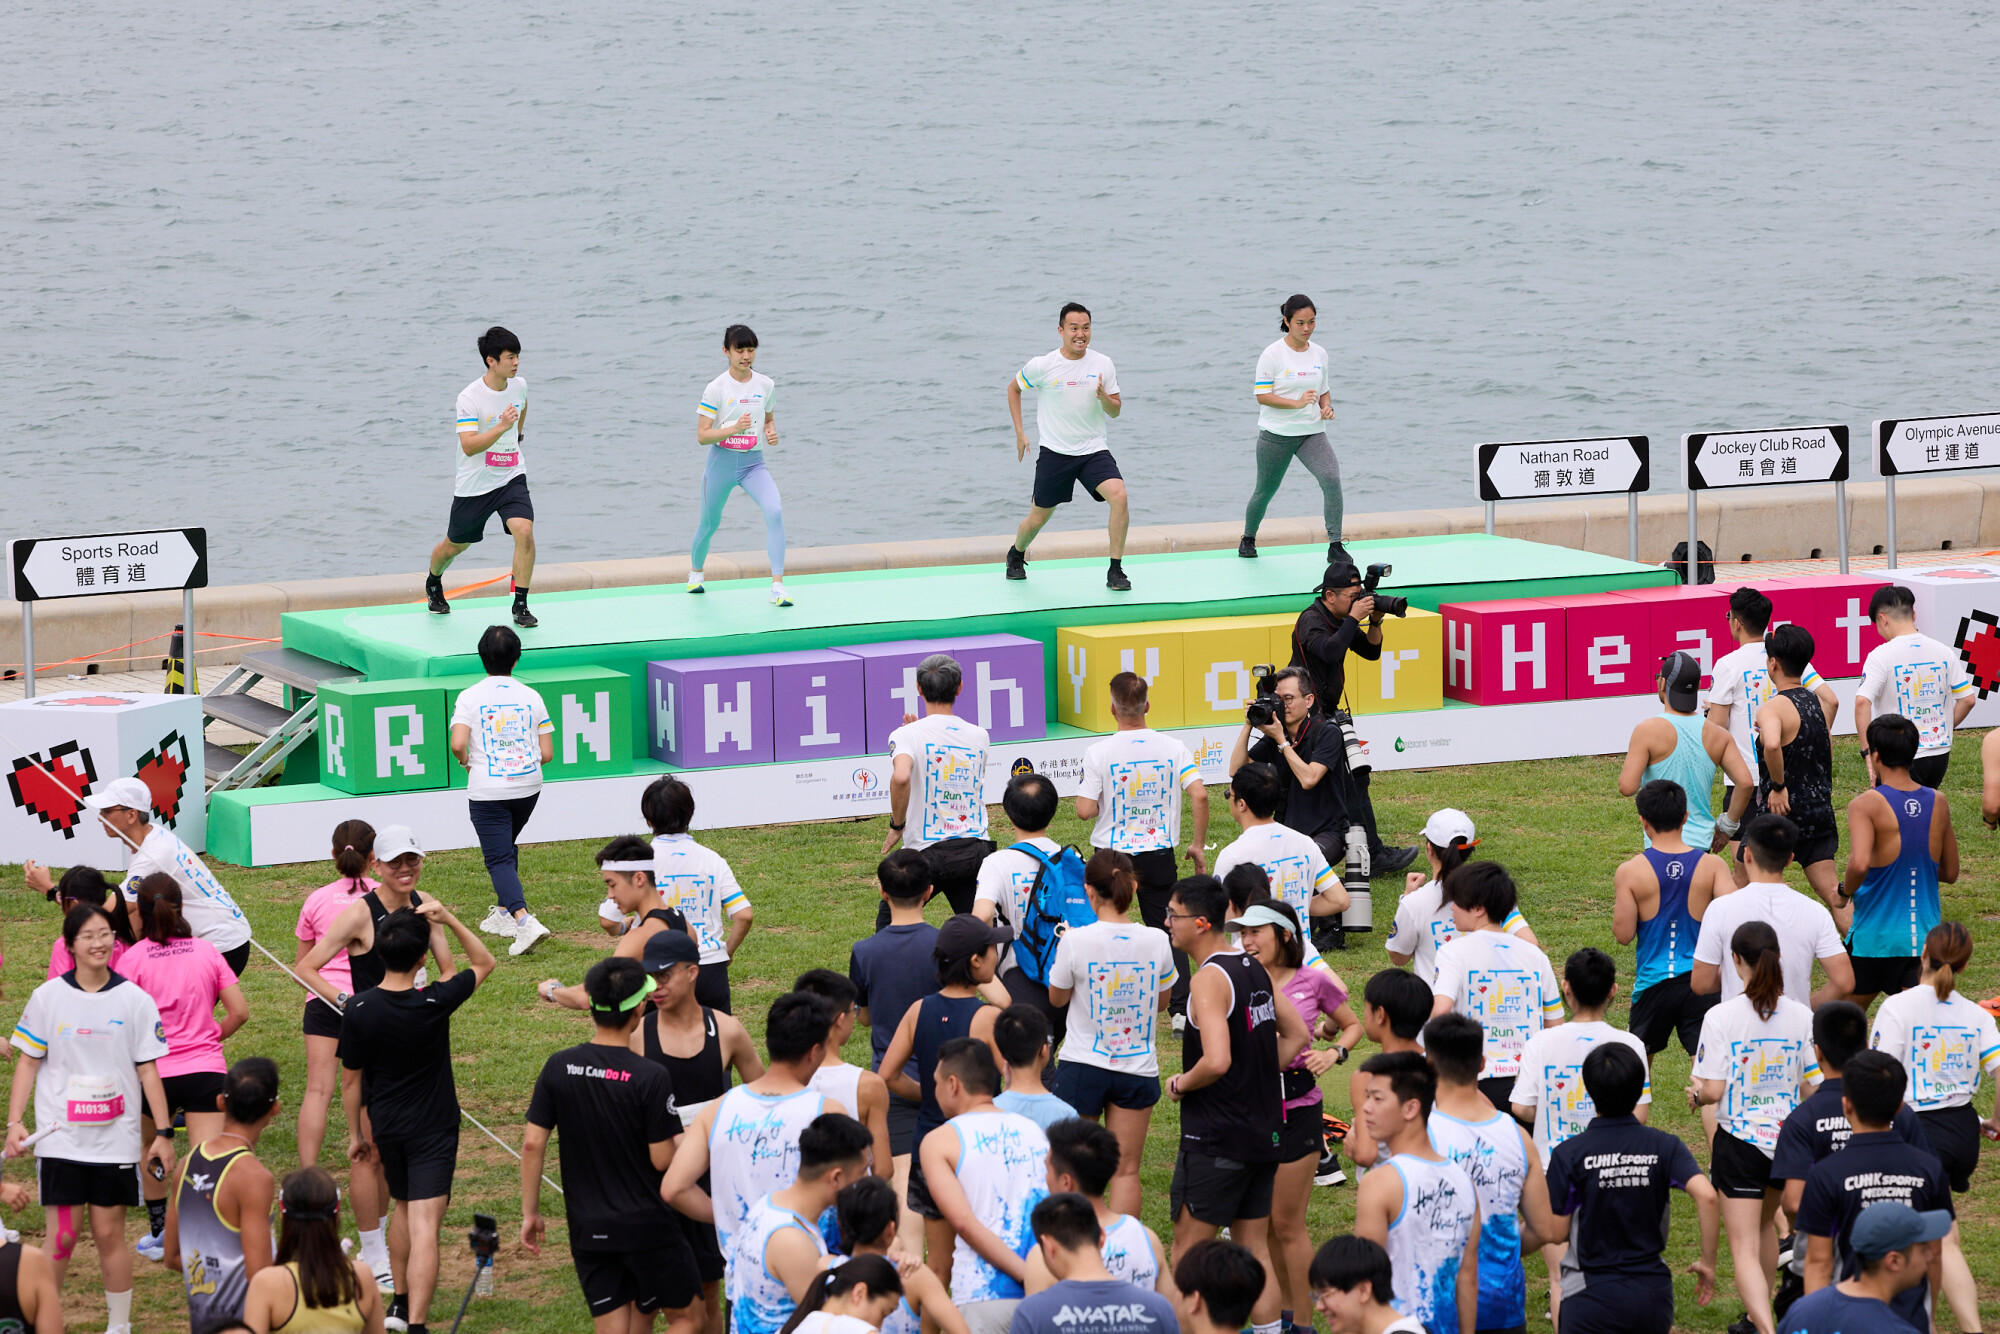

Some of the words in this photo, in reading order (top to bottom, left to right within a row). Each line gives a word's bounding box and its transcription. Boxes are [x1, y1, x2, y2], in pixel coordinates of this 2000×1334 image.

[1905, 425, 1954, 442] Olympic
[1956, 424, 2000, 436] Avenue
[1711, 439, 1757, 456] Jockey
[1759, 437, 1790, 452] Club
[1791, 435, 1826, 450] Road
[1519, 449, 1569, 465] Nathan
[1573, 447, 1609, 462] Road
[1926, 442, 1980, 463] 世運道
[1738, 457, 1797, 477] 馬會道
[1534, 468, 1596, 489] 彌敦道
[61, 544, 113, 563] Sports
[117, 541, 159, 557] Road
[76, 563, 146, 587] 體育道
[1501, 597, 1876, 692] Heat
[1916, 706, 1931, 715] Run
[374, 691, 611, 778] RN
[1208, 741, 1223, 750] JC
[1208, 750, 1223, 758] FIT
[955, 760, 970, 768] JC
[1040, 758, 1084, 770] 香港賽馬
[1202, 758, 1223, 766] CITY
[1053, 769, 1072, 780] Hong
[1142, 774, 1157, 782] JC
[943, 790, 962, 800] Run
[1136, 789, 1157, 797] CITY
[1131, 806, 1151, 815] Run
[943, 822, 968, 830] Heart
[681, 889, 697, 897] JC
[149, 951, 171, 959] HONG
[172, 947, 194, 955] KONG
[1504, 987, 1521, 995] JC
[1504, 996, 1521, 1004] FIT
[1108, 1007, 1126, 1015] Run
[1497, 1005, 1521, 1013] CITY
[1491, 1026, 1514, 1037] Run
[1946, 1043, 1964, 1052] JC
[1766, 1056, 1784, 1064] JC
[1946, 1053, 1963, 1061] FIT
[1494, 1065, 1520, 1074] Hear
[1766, 1065, 1784, 1073] FIT
[1759, 1074, 1784, 1083] CITY
[1935, 1082, 1957, 1093] Run
[1751, 1094, 1775, 1106] Run
[1576, 1102, 1594, 1110] CIT
[1584, 1152, 1621, 1170] CUHK
[1598, 1165, 1650, 1179] MEDICINE
[1844, 1172, 1882, 1191] CUHK
[1881, 1174, 1925, 1188] SPORTS
[1861, 1187, 1913, 1200] MEDICINE
[1052, 1303, 1157, 1326] AVATAR
[1061, 1326, 1076, 1334] THE
